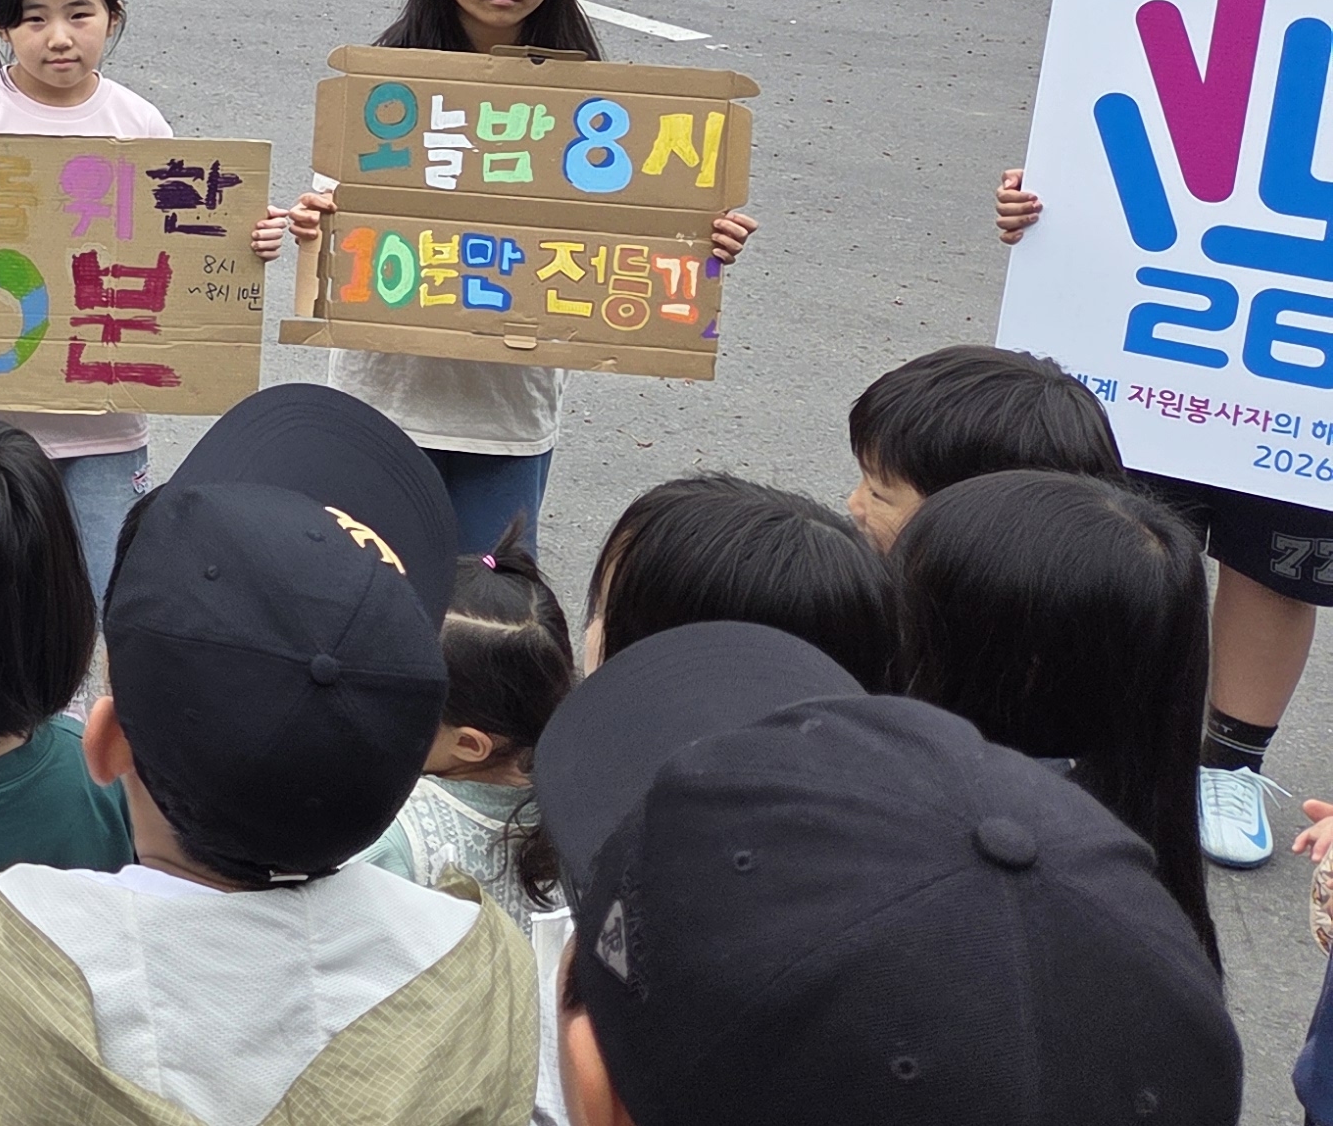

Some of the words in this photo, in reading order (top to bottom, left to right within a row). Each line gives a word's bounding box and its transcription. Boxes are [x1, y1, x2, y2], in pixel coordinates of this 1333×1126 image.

[357, 80, 556, 191] 오늘밤
[563, 97, 727, 195] 8시
[58, 153, 244, 241] 위한
[203, 254, 236, 275] 8시
[339, 226, 527, 314] 10분만
[1127, 384, 1302, 440] 자원봉사자의
[1253, 444, 1333, 483] 2026
